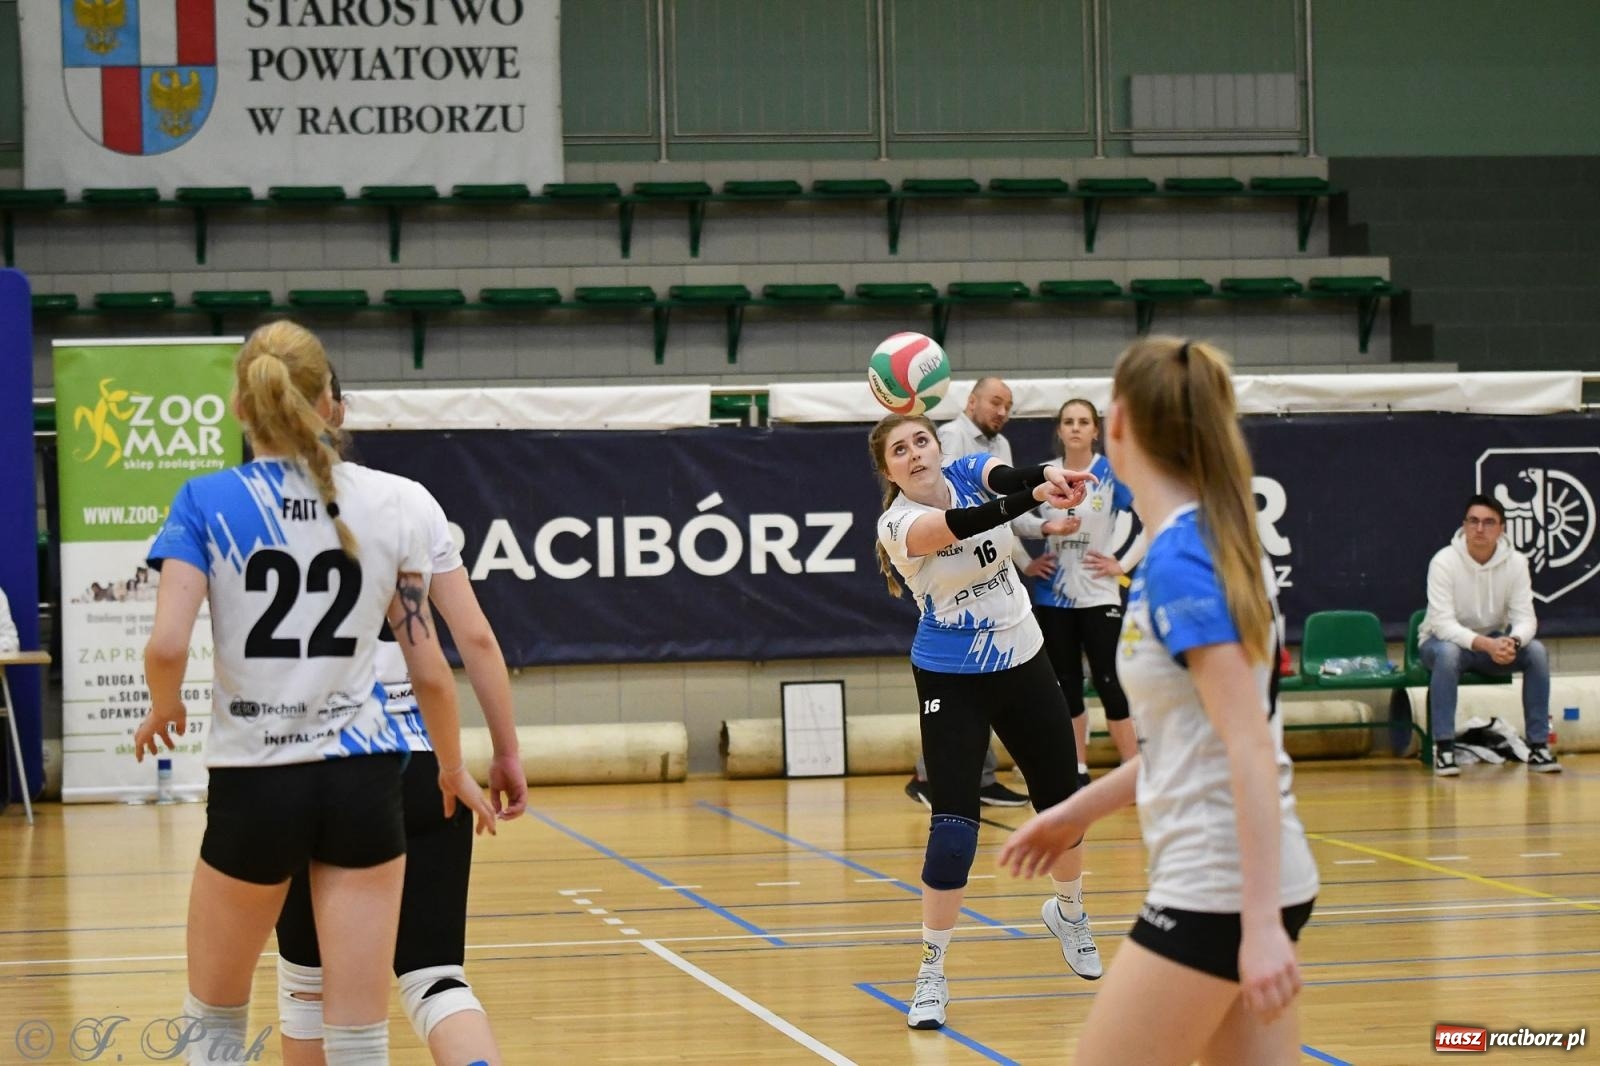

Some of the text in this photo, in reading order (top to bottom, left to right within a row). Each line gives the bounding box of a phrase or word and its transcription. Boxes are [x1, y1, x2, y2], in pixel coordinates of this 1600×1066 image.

[246, 0, 524, 28] STAROSTWO
[249, 46, 520, 81] POWIATOWE
[246, 104, 526, 135] W RACIBORZU
[129, 394, 225, 426] ZOO
[123, 426, 225, 457] MAR
[124, 459, 225, 470] sklep zoologiczny
[84, 506, 169, 525] WWW.ZOO-
[282, 498, 318, 521] FAIT
[936, 546, 964, 557] VOLLEY
[973, 539, 998, 569] 16
[244, 548, 363, 659] 22
[100, 707, 152, 719] OPAWSK
[261, 703, 307, 715] Technik
[924, 698, 941, 715] 16
